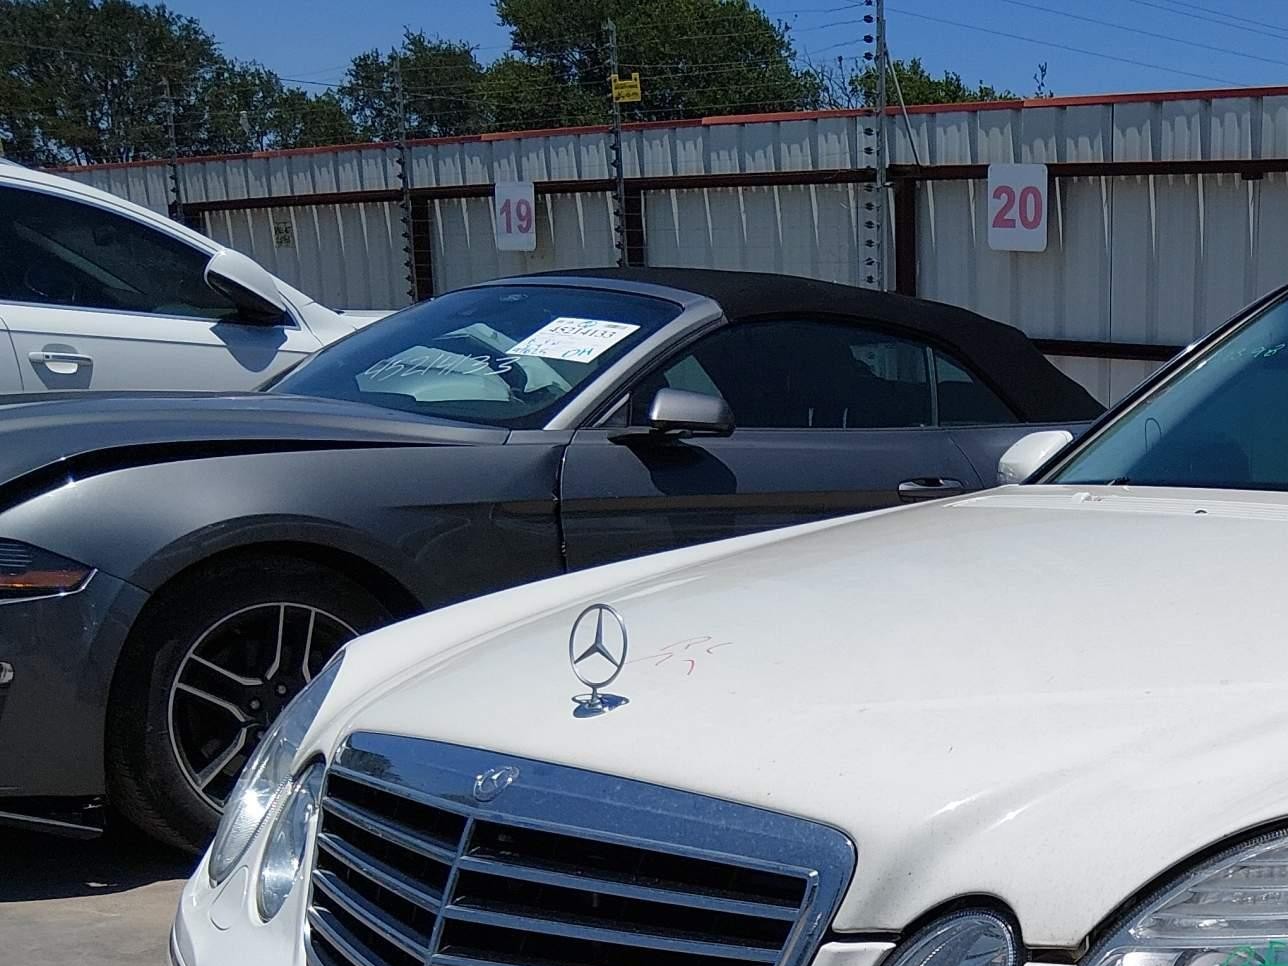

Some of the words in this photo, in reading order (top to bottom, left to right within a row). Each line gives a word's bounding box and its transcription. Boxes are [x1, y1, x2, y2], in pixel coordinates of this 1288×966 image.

[500, 198, 532, 233] 19
[992, 185, 1042, 230] 20
[549, 326, 616, 338] 45214133
